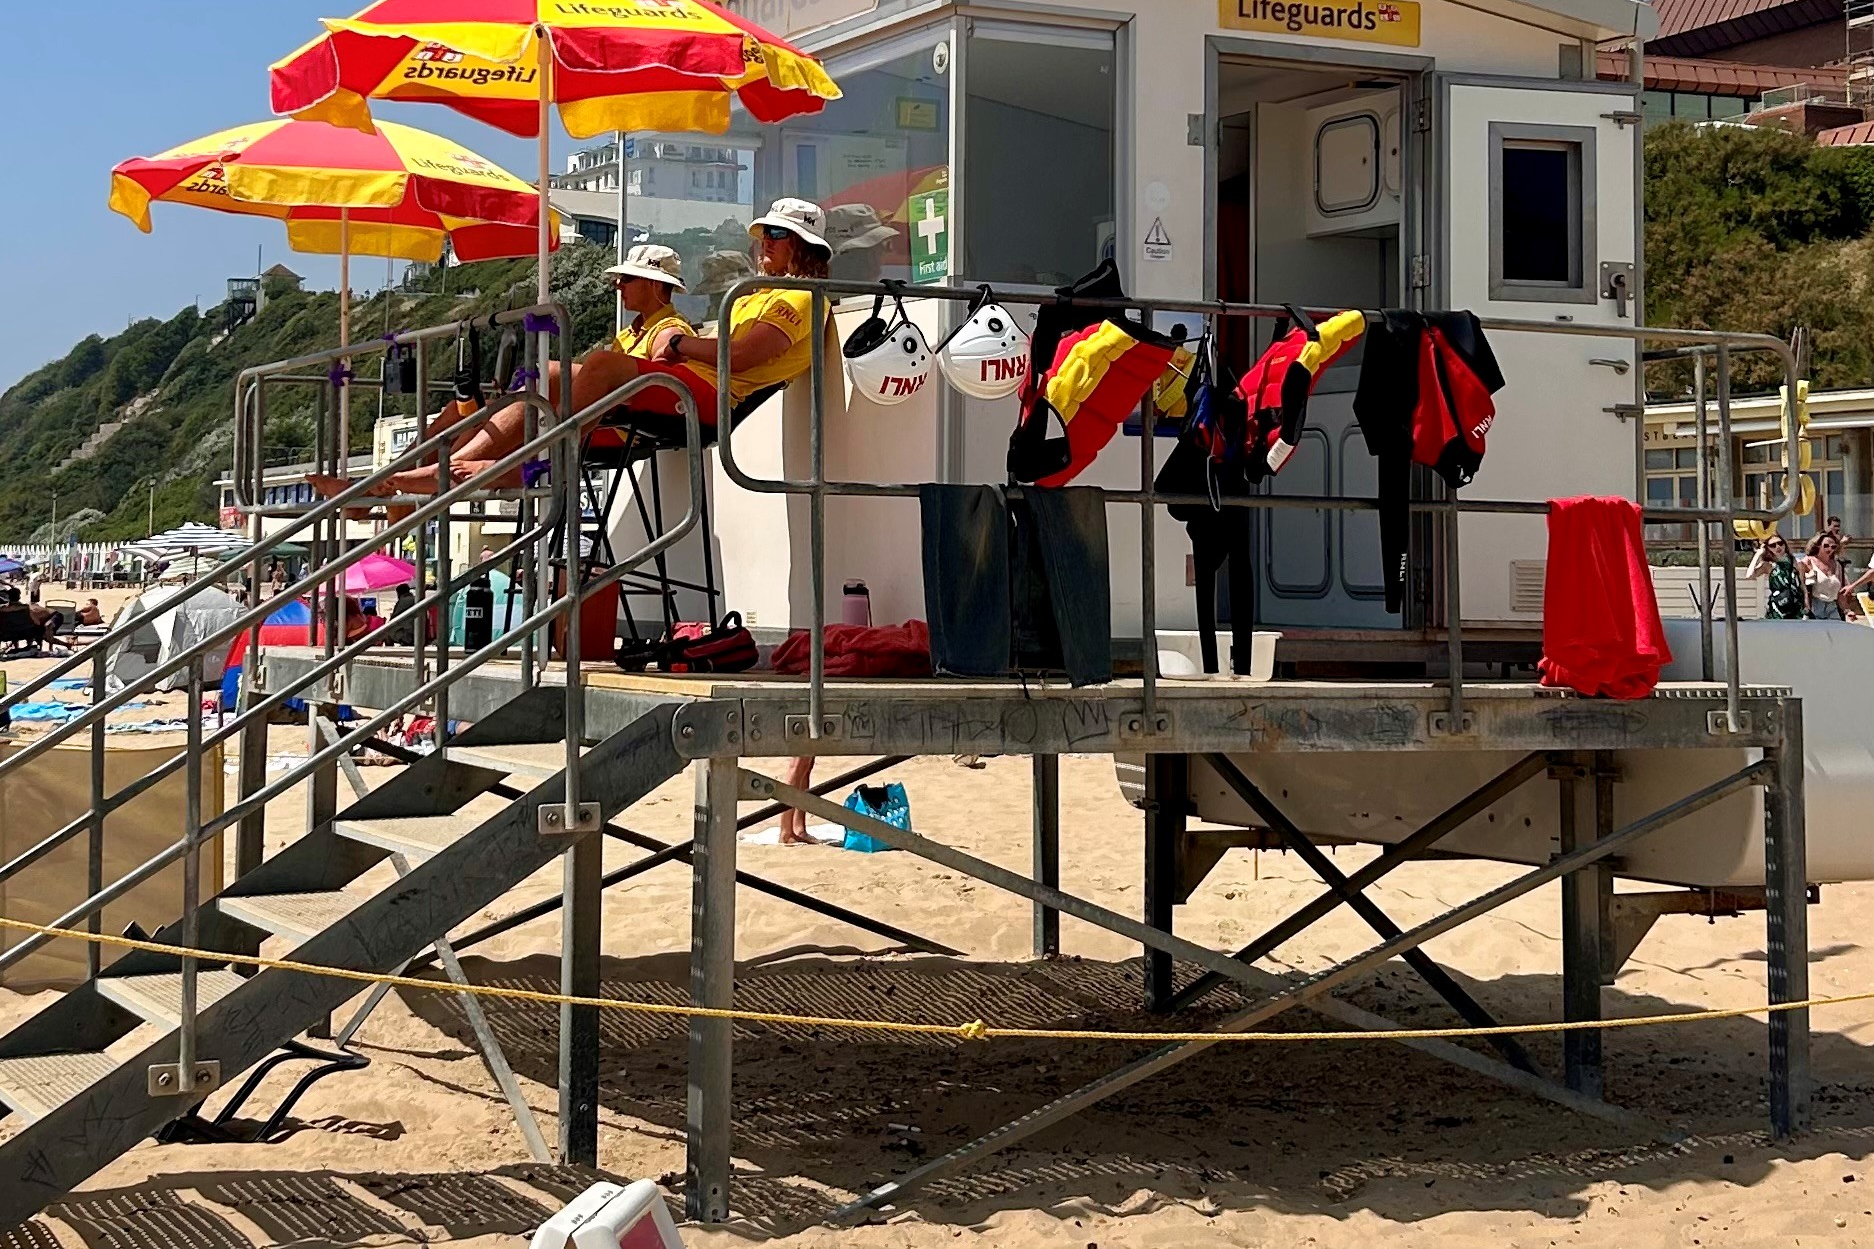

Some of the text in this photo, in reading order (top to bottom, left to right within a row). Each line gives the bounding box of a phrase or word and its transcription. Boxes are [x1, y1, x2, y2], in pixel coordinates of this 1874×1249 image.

[554, 2, 703, 20] Lifeguards
[411, 157, 511, 181] Lifeguards
[919, 260, 935, 275] First
[776, 305, 803, 326] RNLI
[980, 353, 1027, 382] RNLI
[879, 372, 928, 397] RNLI
[1470, 414, 1493, 439] RNLI
[1399, 553, 1408, 582] RNLI
